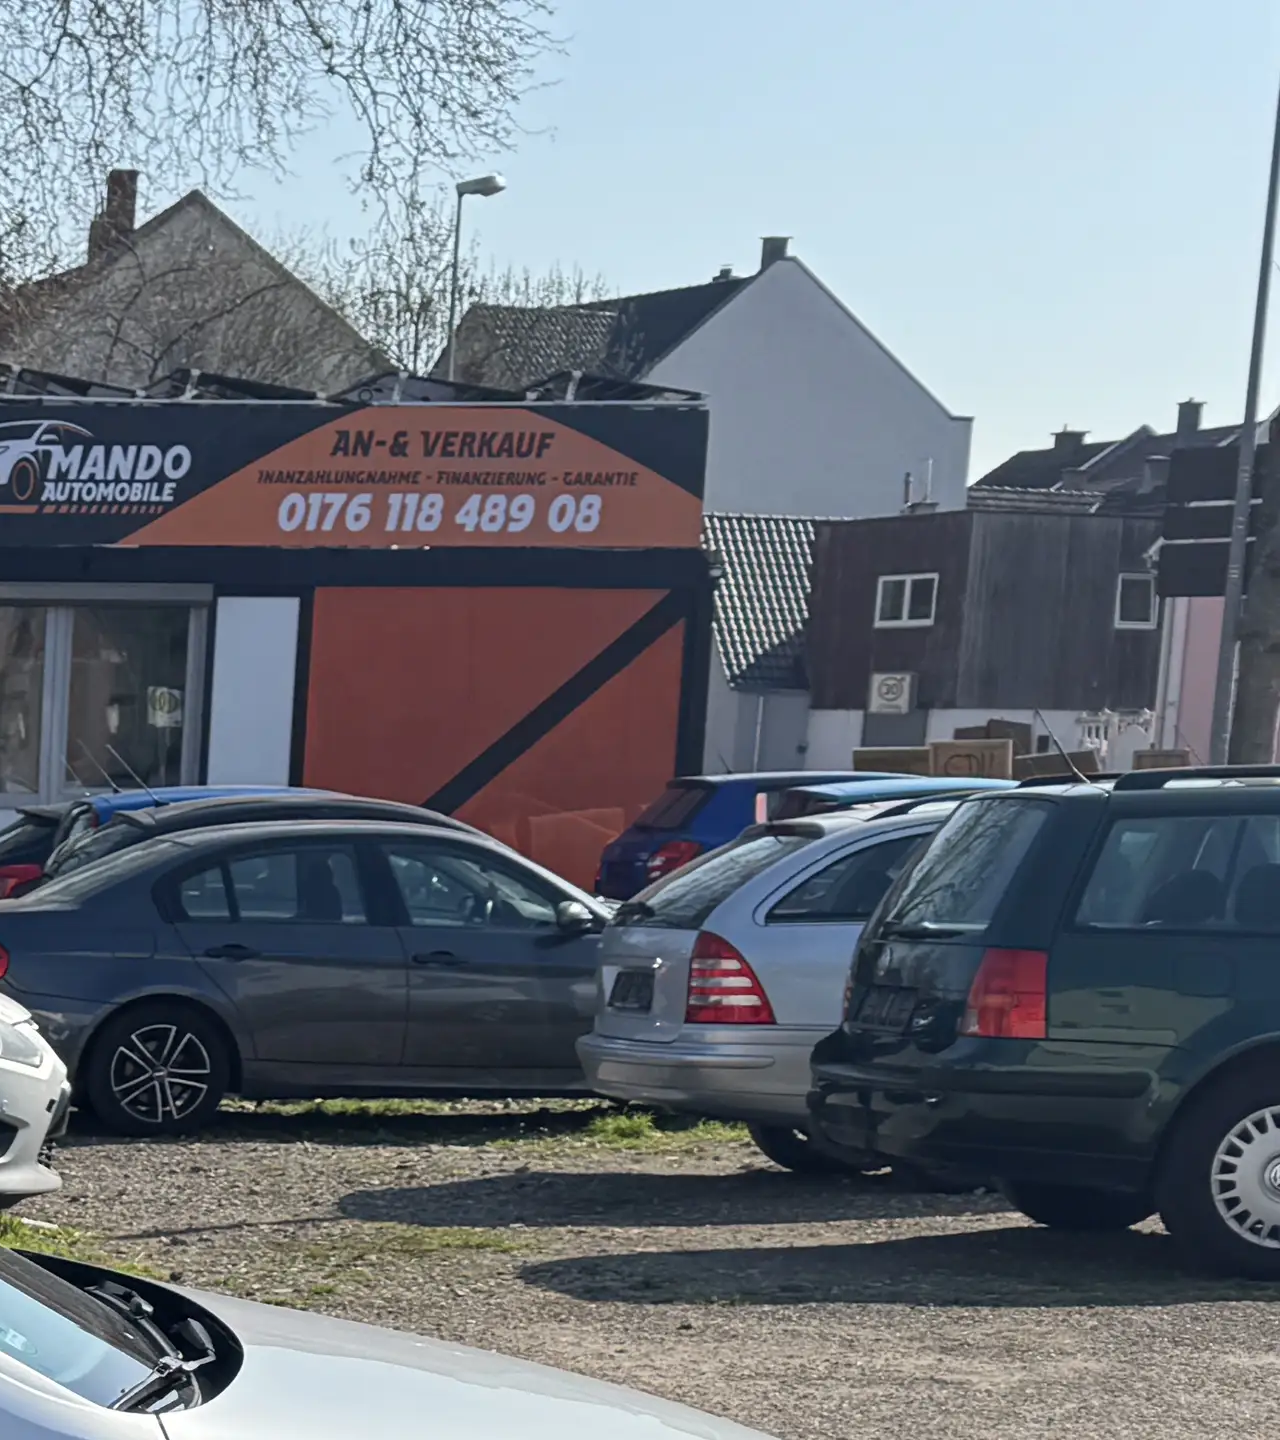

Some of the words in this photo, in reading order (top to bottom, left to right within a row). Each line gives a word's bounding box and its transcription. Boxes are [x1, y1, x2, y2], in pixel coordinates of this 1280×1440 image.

[420, 431, 555, 459] VERKAUF
[47, 444, 192, 480] MANDO
[40, 482, 177, 502] AUTOMOBILE
[257, 469, 422, 486] INANZAHLUNGNAHME
[436, 470, 547, 487] FINANZIERUNG
[563, 471, 639, 487] GARANTIE
[277, 492, 372, 532] 0176
[384, 493, 444, 532] 118
[455, 493, 535, 533] 489
[547, 494, 603, 533] 08
